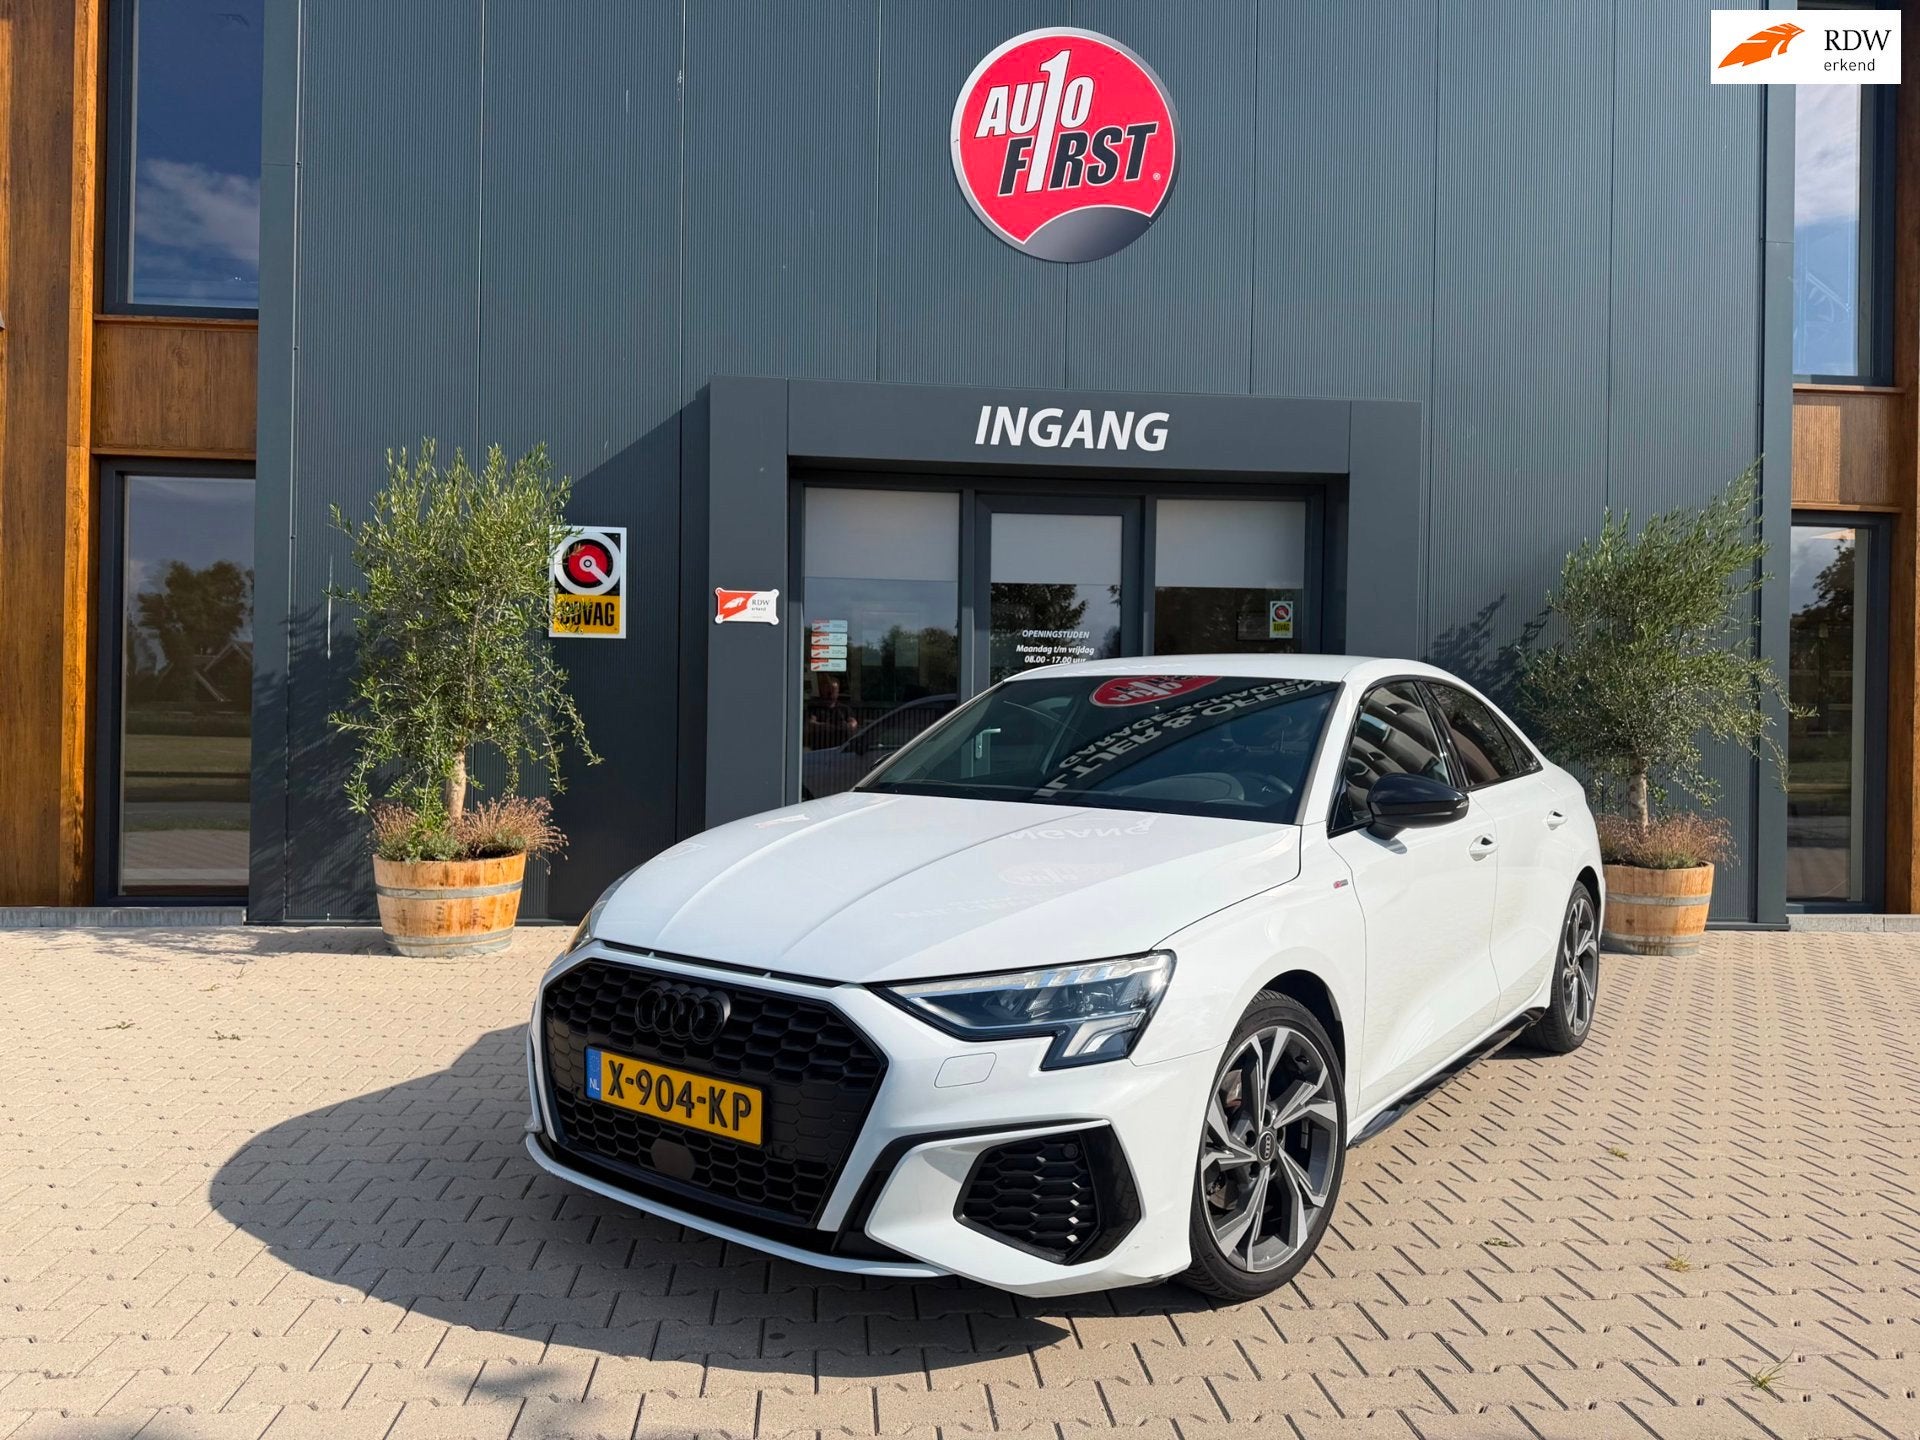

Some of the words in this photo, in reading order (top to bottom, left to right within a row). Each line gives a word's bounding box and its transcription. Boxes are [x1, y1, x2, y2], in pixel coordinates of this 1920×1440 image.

[974, 405, 1170, 452] INGANG
[1016, 644, 1053, 655] Maandag
[1053, 645, 1067, 654] t/m
[1068, 645, 1095, 656] vrijdag
[1024, 655, 1046, 664] 08.00
[1051, 655, 1072, 665] 17.00
[589, 1077, 600, 1091] NL
[608, 1060, 751, 1131] X-904-KP
